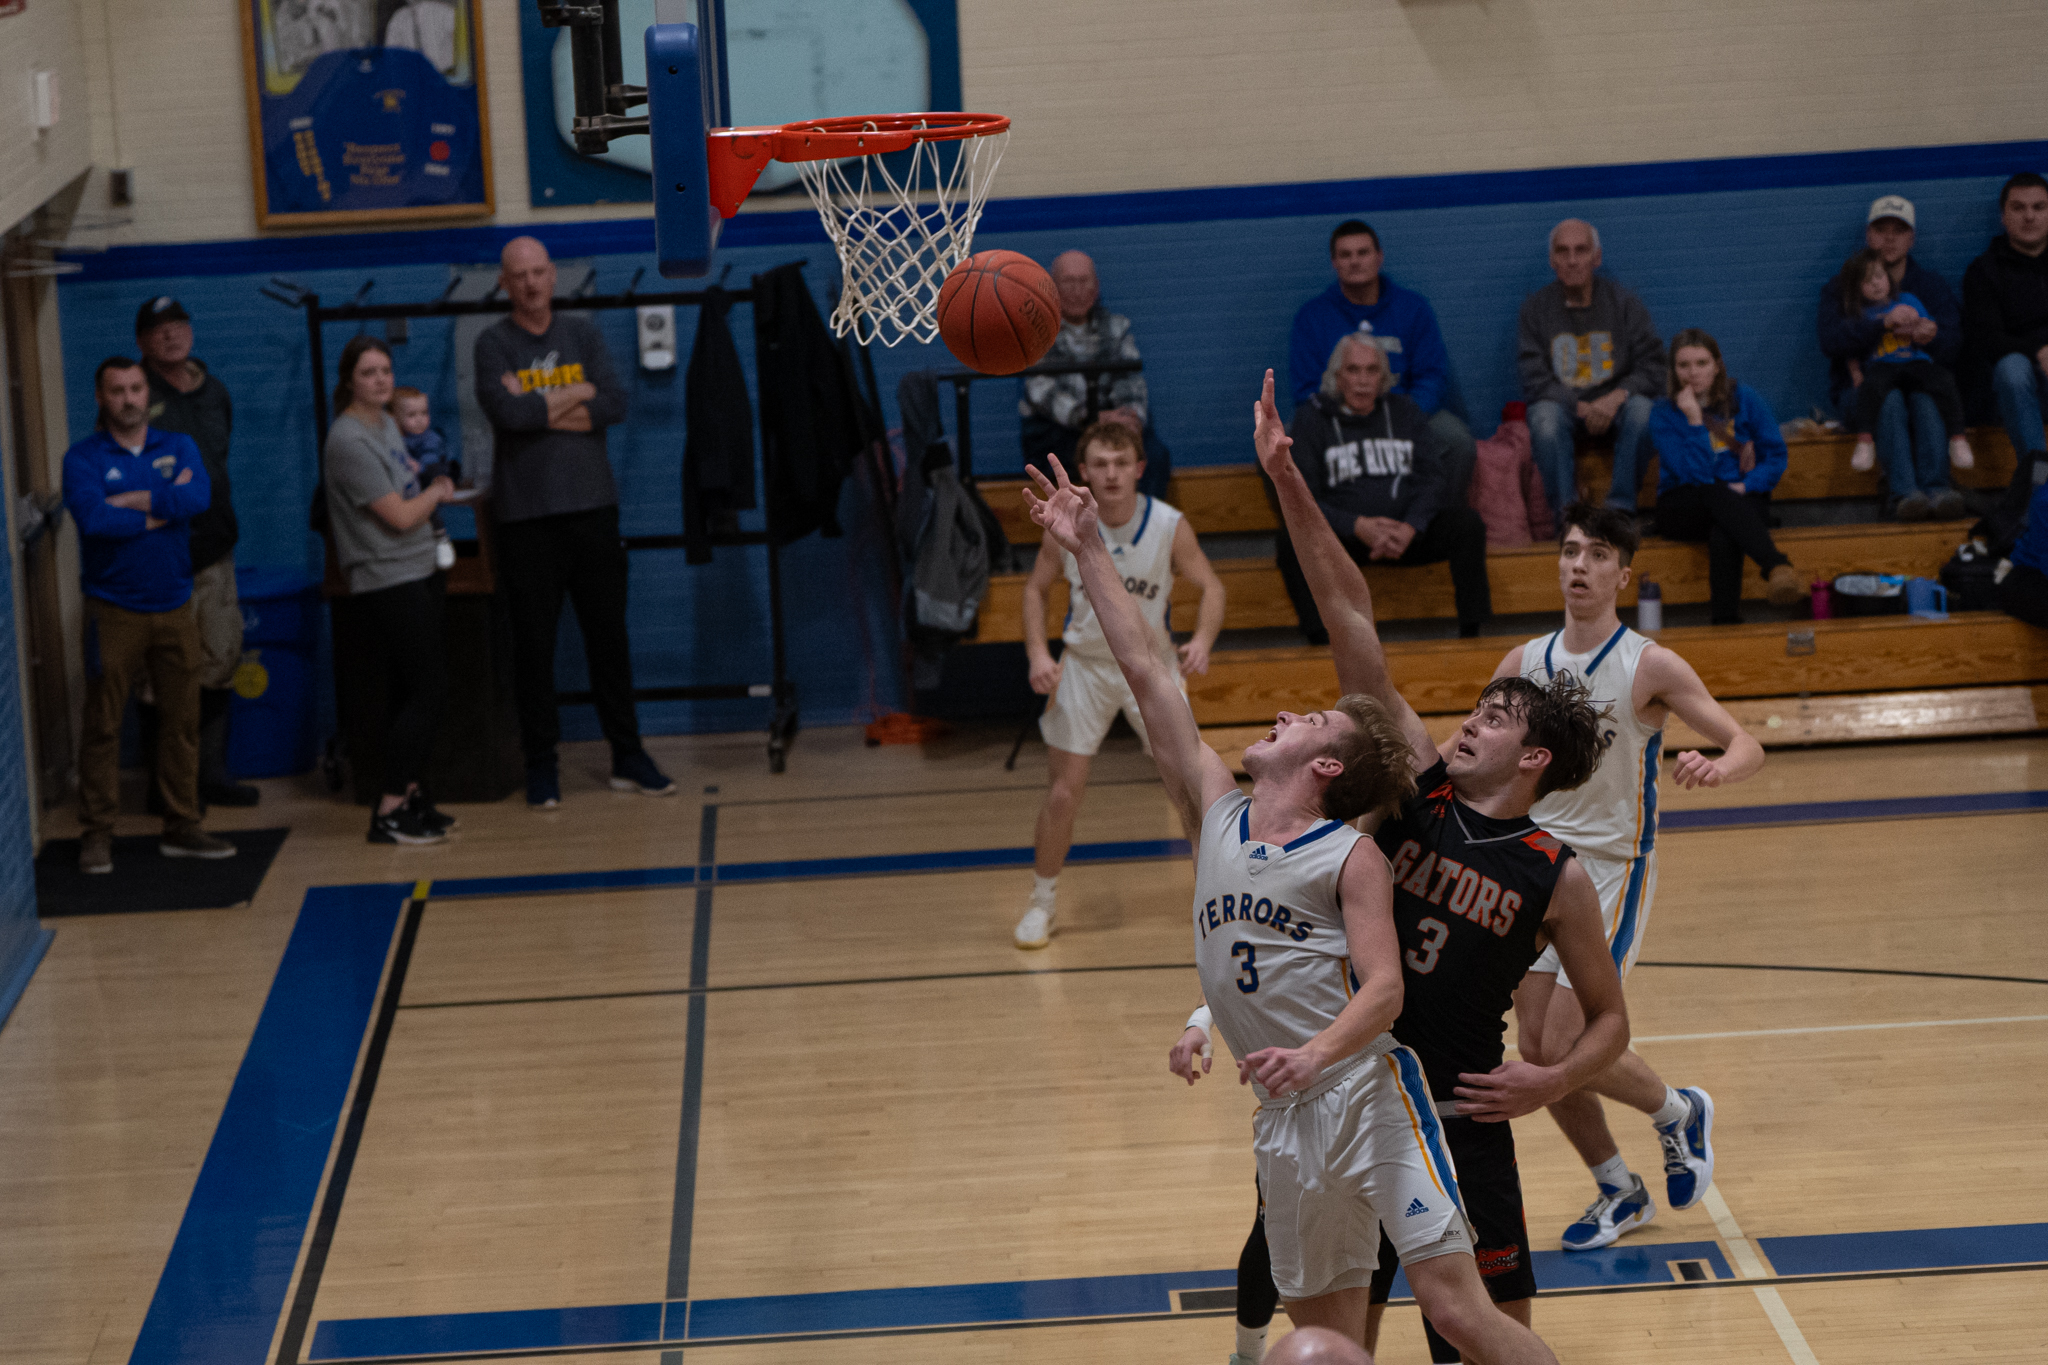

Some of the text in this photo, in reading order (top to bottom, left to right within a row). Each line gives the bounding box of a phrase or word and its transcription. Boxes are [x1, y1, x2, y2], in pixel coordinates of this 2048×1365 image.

[1325, 441, 1361, 487] THE
[1249, 852, 1269, 861] adidas
[1392, 838, 1523, 937] GATORS
[1199, 893, 1313, 942] TERRORS
[1231, 941, 1259, 995] 3
[1405, 916, 1450, 975] 3
[1405, 1206, 1429, 1218] adidas
